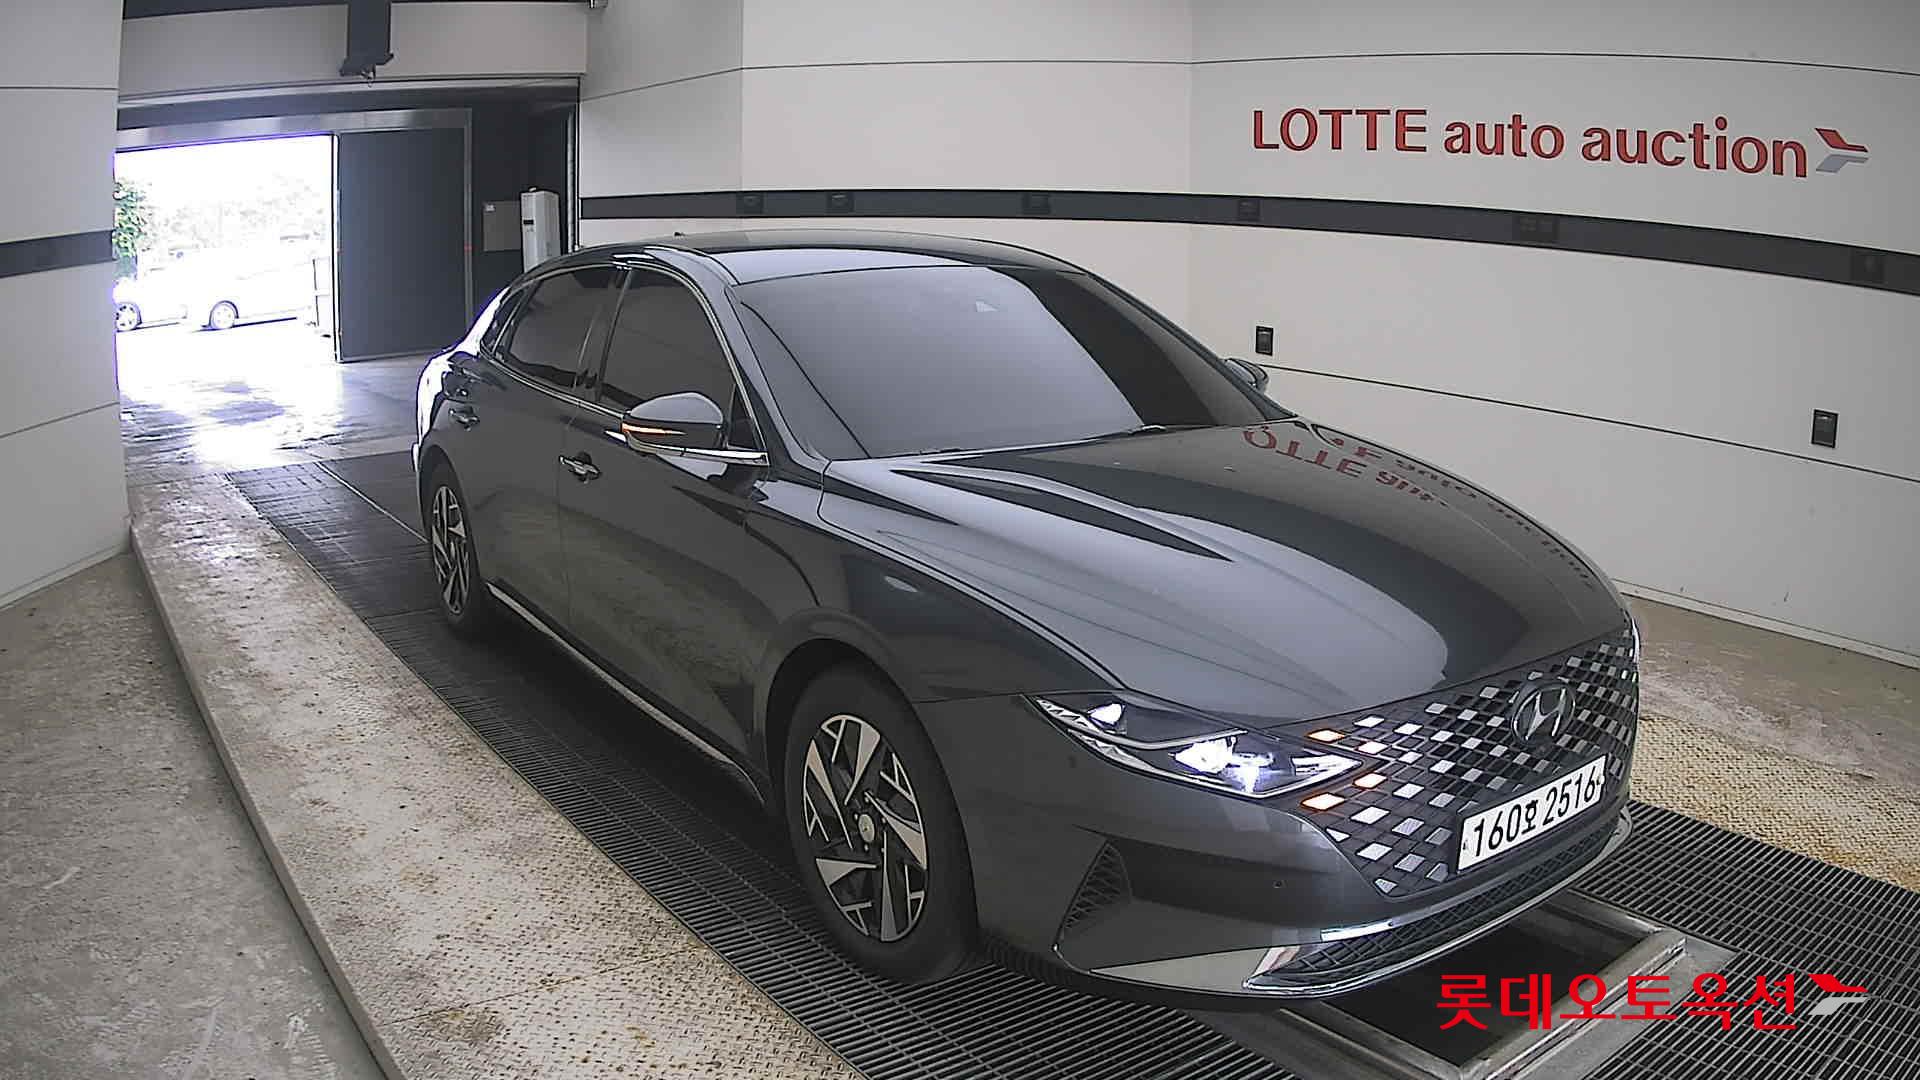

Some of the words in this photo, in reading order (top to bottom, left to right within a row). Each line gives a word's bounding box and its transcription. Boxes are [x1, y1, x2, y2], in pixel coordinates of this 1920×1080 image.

[1253, 107, 1428, 153] LOTTE
[1443, 113, 1566, 160] auto
[1581, 115, 1809, 179] auction
